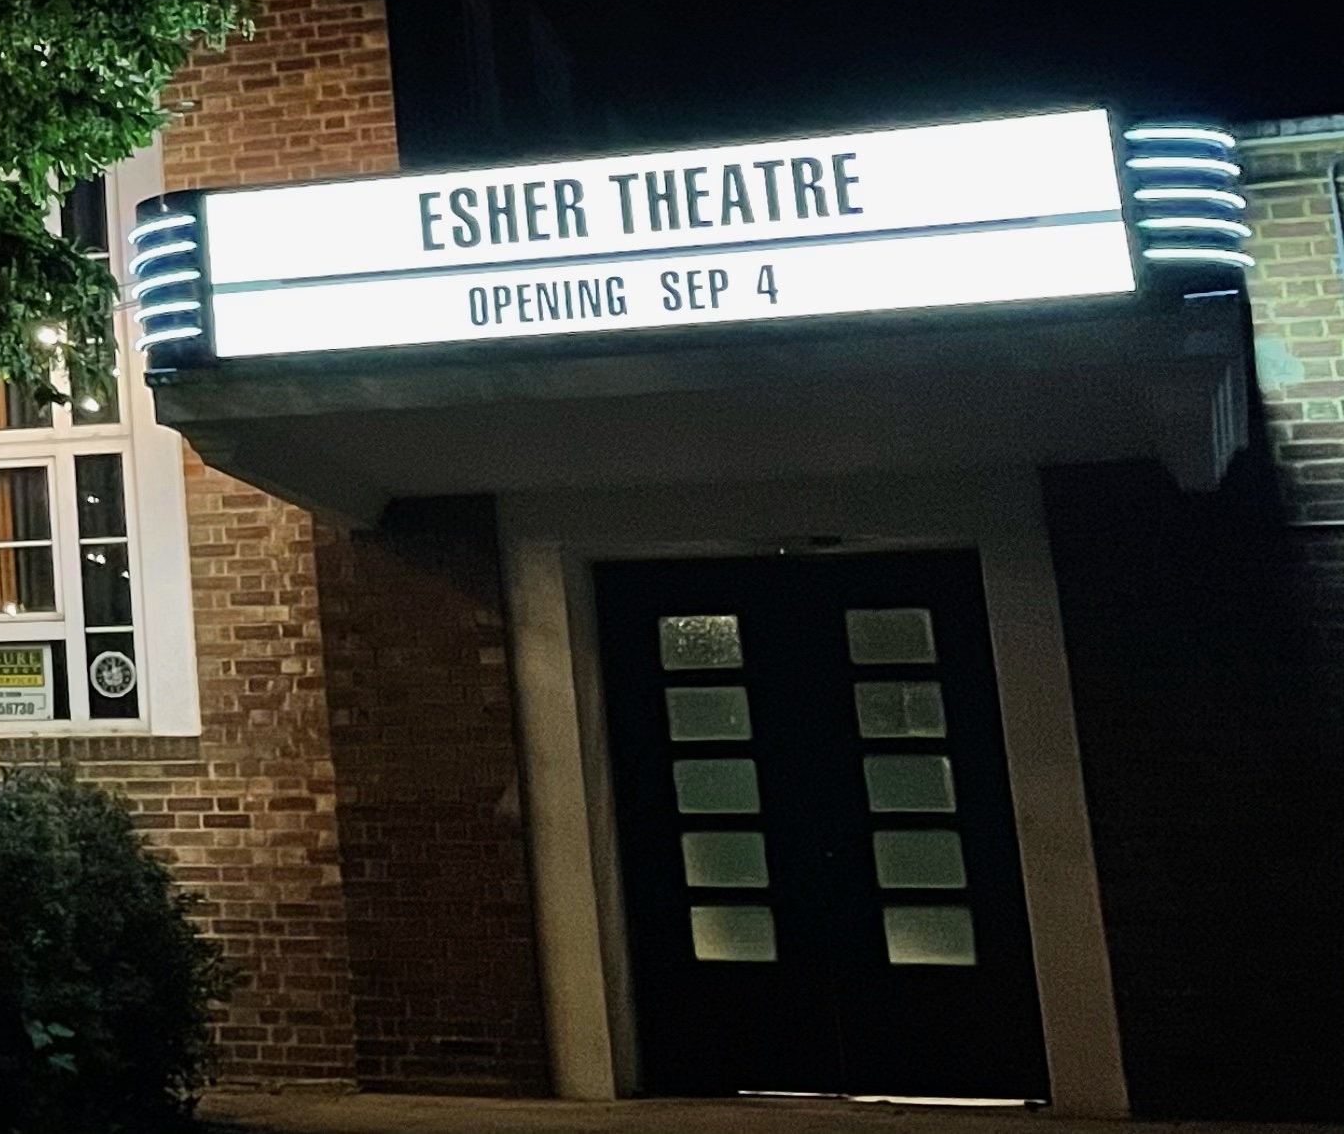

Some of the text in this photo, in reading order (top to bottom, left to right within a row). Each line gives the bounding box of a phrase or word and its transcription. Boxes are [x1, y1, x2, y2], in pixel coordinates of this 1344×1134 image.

[418, 152, 864, 251] ESHER THEATRE
[469, 264, 779, 326] OPENING SEP 4
